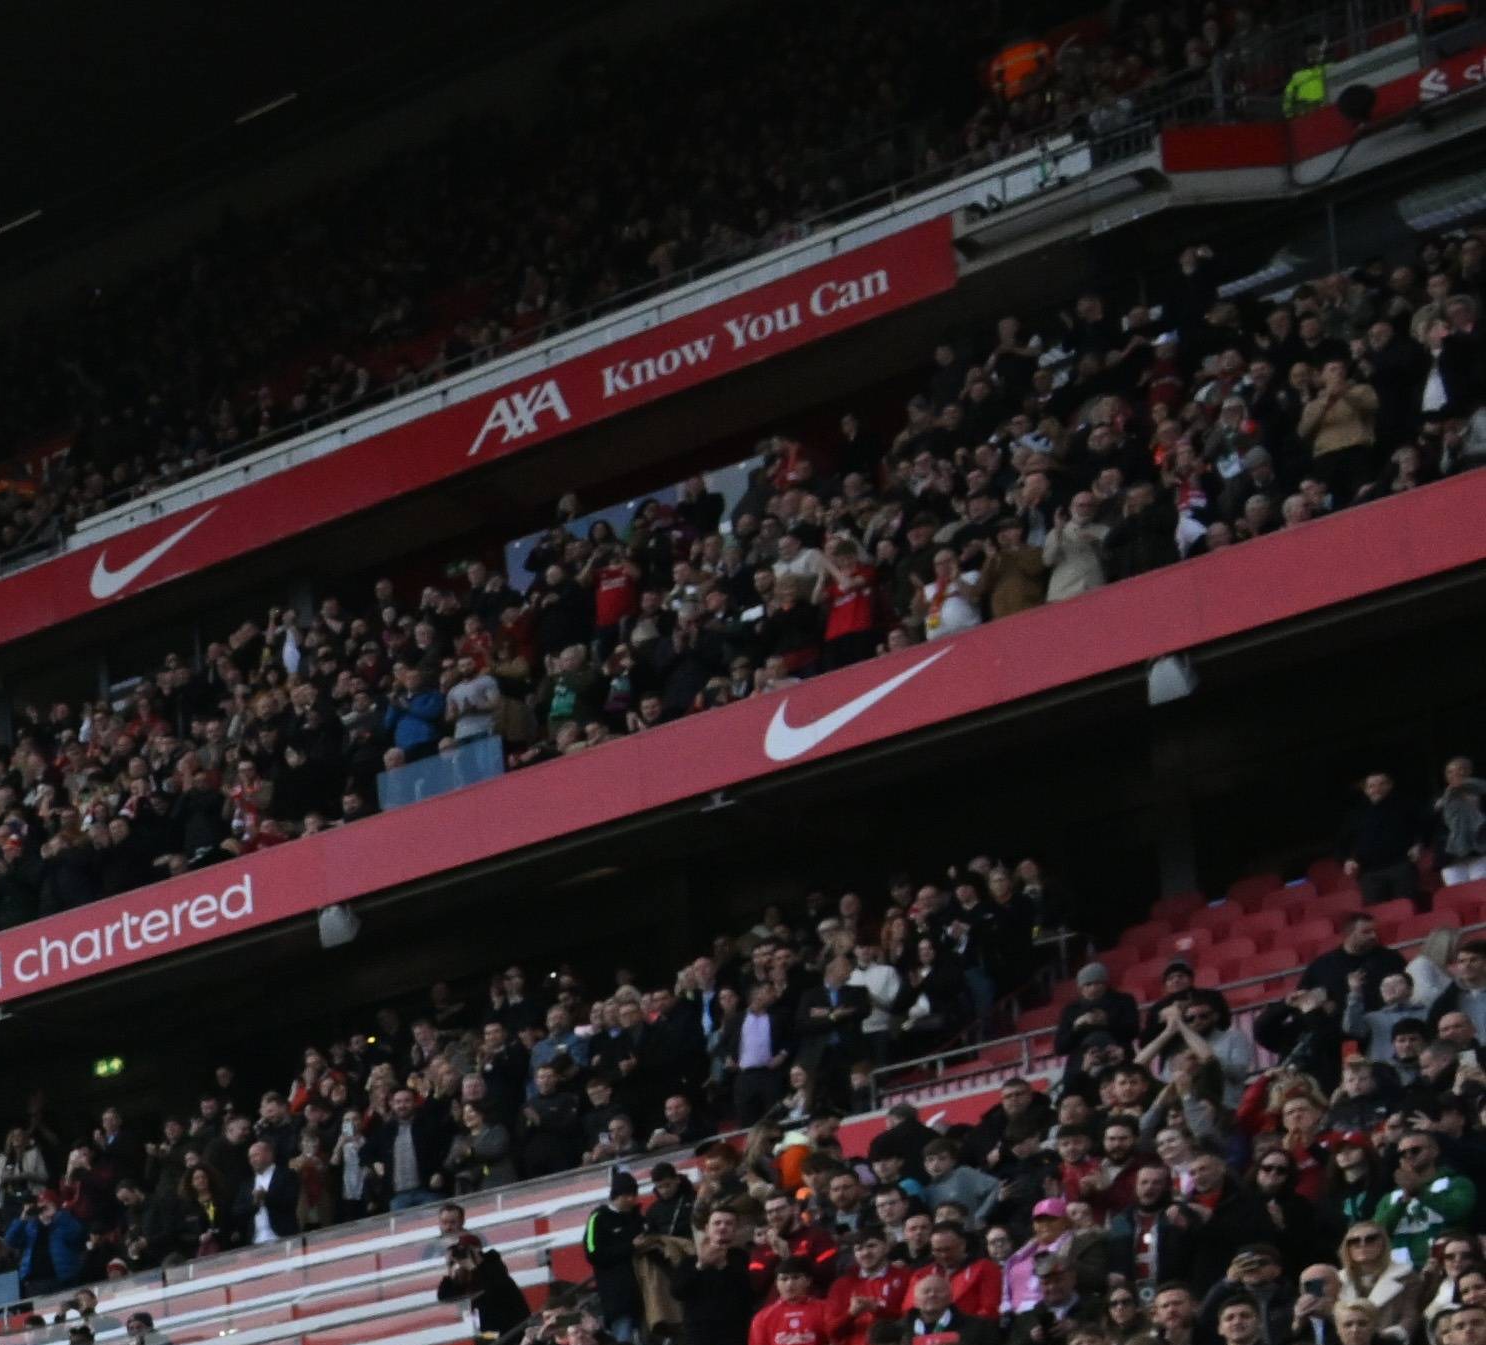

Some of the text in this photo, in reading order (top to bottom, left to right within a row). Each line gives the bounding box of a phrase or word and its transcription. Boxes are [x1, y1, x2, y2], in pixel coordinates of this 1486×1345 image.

[468, 269, 890, 456] AXA Know You Can
[15, 874, 254, 988] chartered
